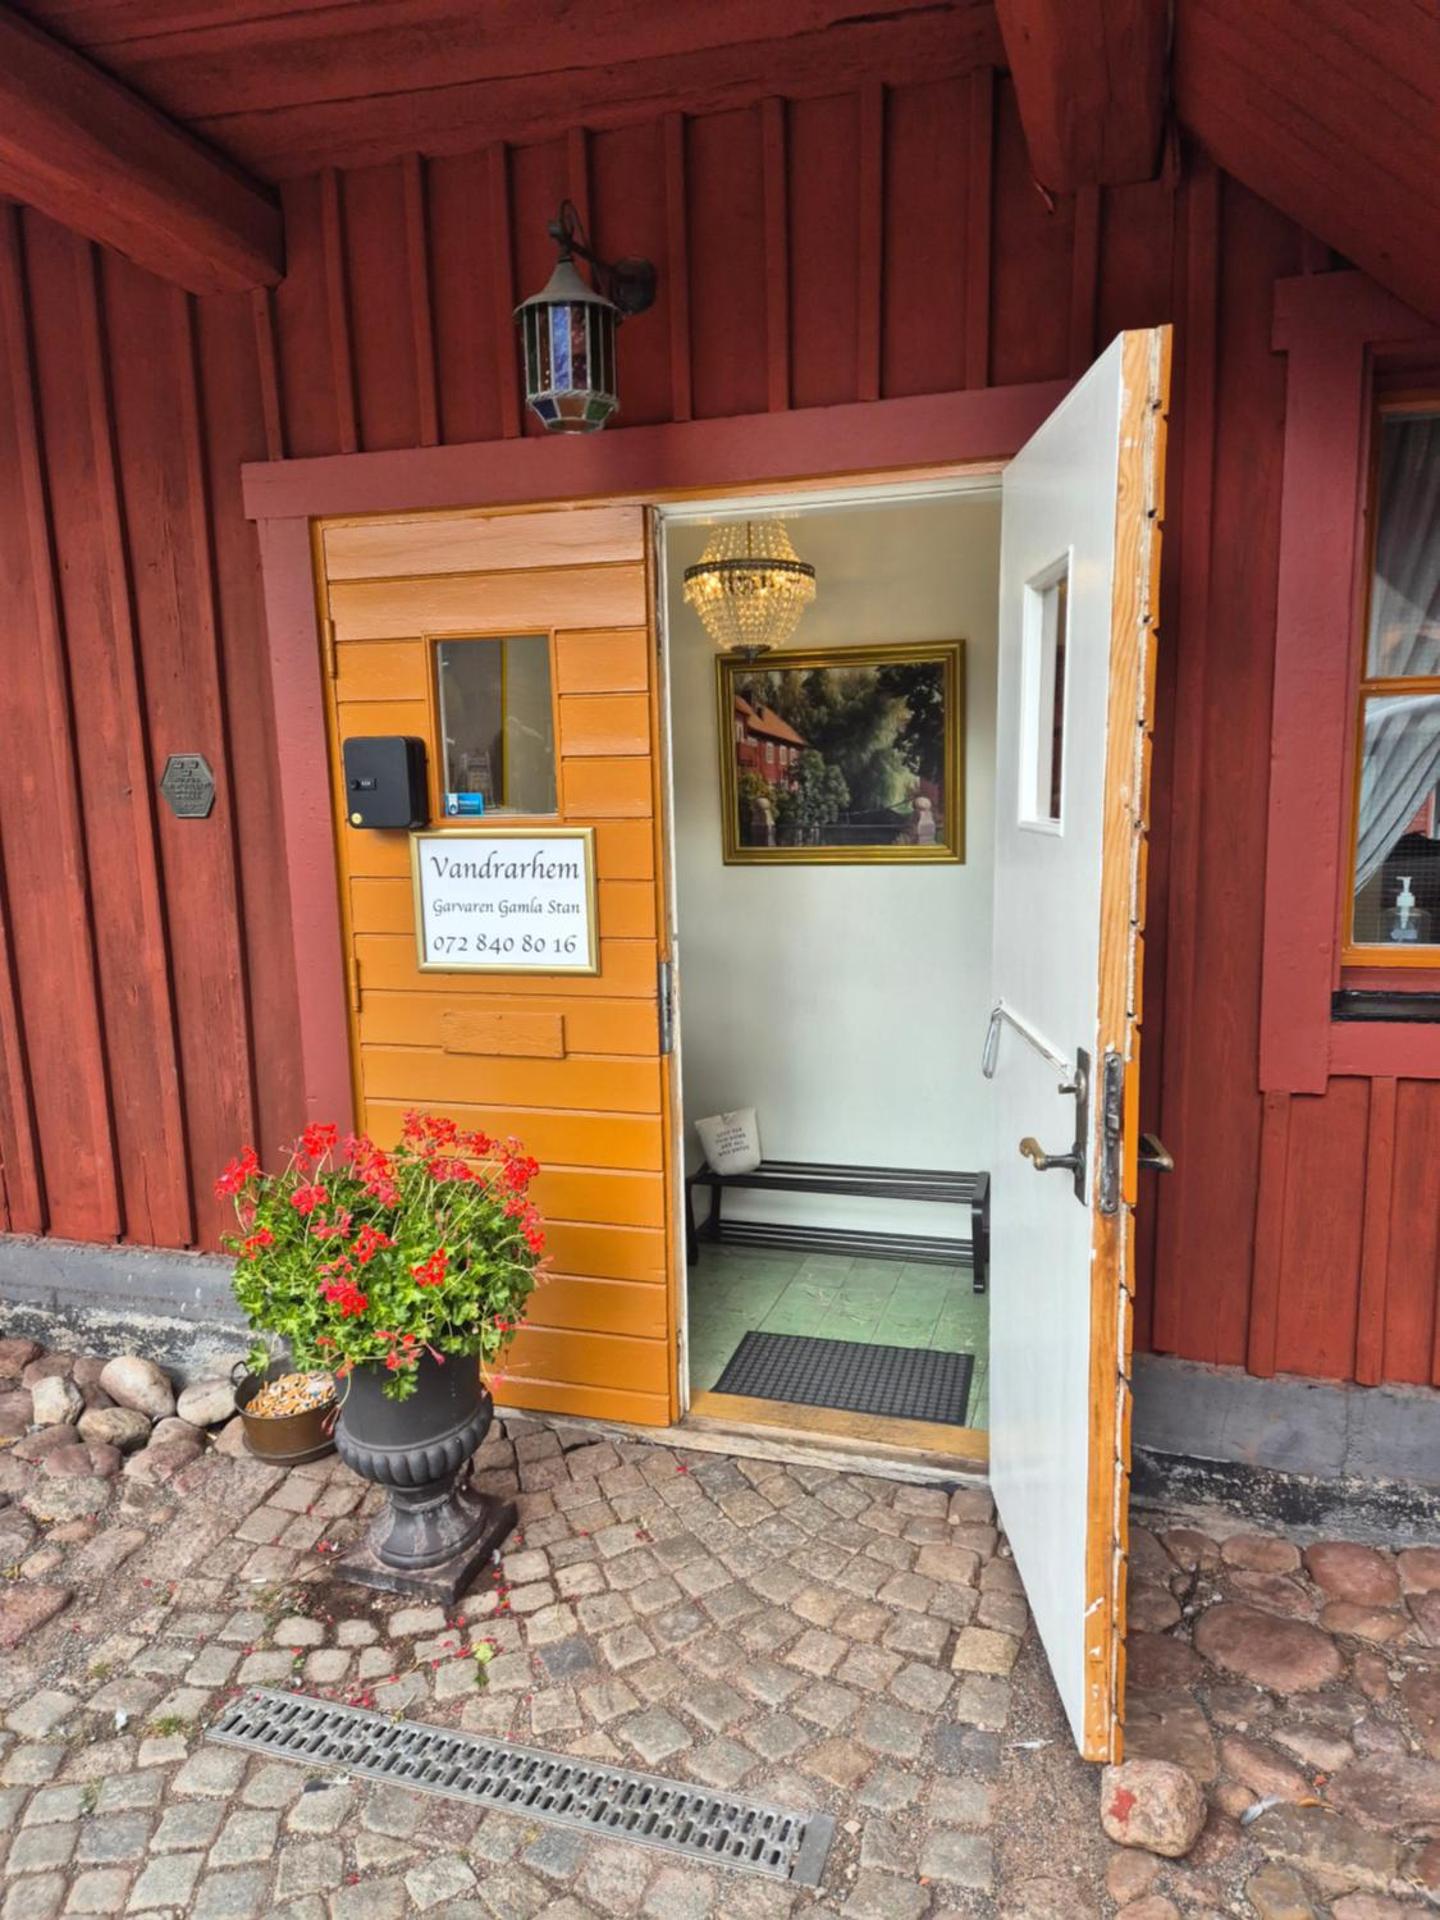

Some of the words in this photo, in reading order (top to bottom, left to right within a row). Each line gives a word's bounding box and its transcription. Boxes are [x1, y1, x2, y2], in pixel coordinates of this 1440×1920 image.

[431, 850, 579, 879] Vandrarhem
[433, 899, 493, 916] Garvaren
[498, 897, 542, 917] Gamla
[548, 900, 579, 913] Stan
[434, 936, 467, 953] 072
[476, 934, 514, 954] 840
[521, 935, 545, 952] 80
[554, 935, 577, 953] 16
